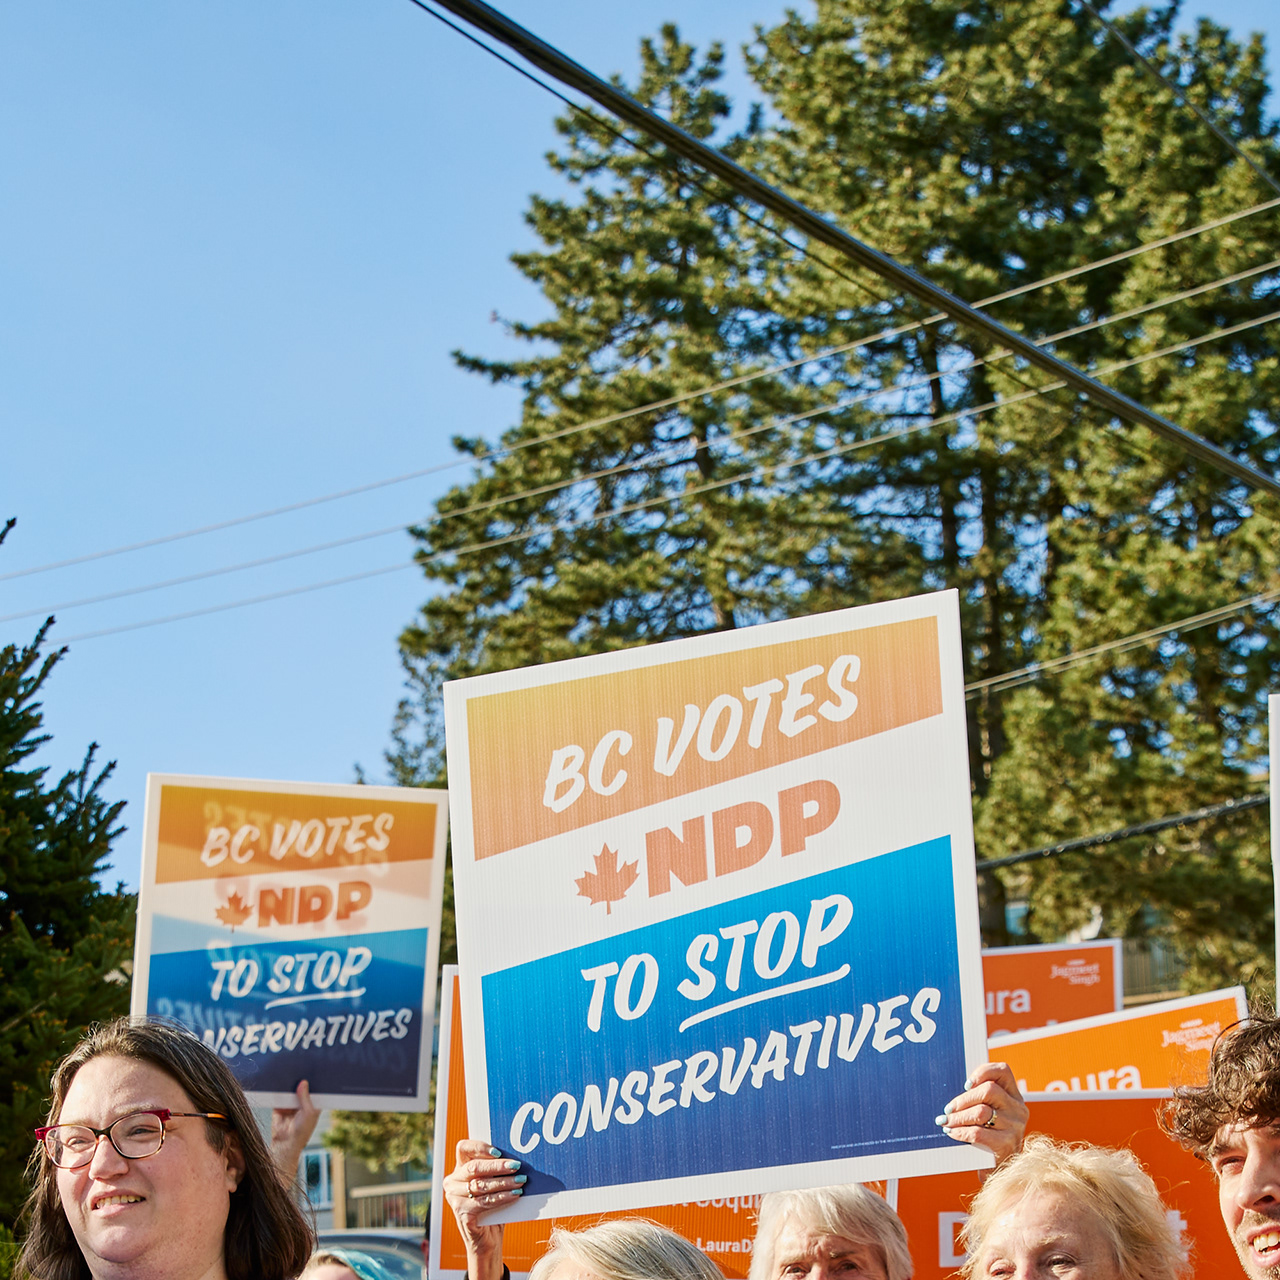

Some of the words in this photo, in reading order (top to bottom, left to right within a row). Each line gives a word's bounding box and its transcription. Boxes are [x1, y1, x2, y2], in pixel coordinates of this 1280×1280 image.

[543, 729, 633, 812] BC
[653, 654, 861, 776] VOTES
[200, 824, 260, 868] BC
[269, 812, 394, 860] VOTES
[645, 779, 841, 898] NDP
[258, 881, 373, 928] NDP
[211, 959, 259, 1001] TO
[266, 946, 372, 994] STOP
[581, 953, 659, 1032] TO
[677, 894, 854, 1001] STOP
[204, 1008, 413, 1058] NSERVATIVES
[510, 987, 941, 1154] CONSERVATIVES
